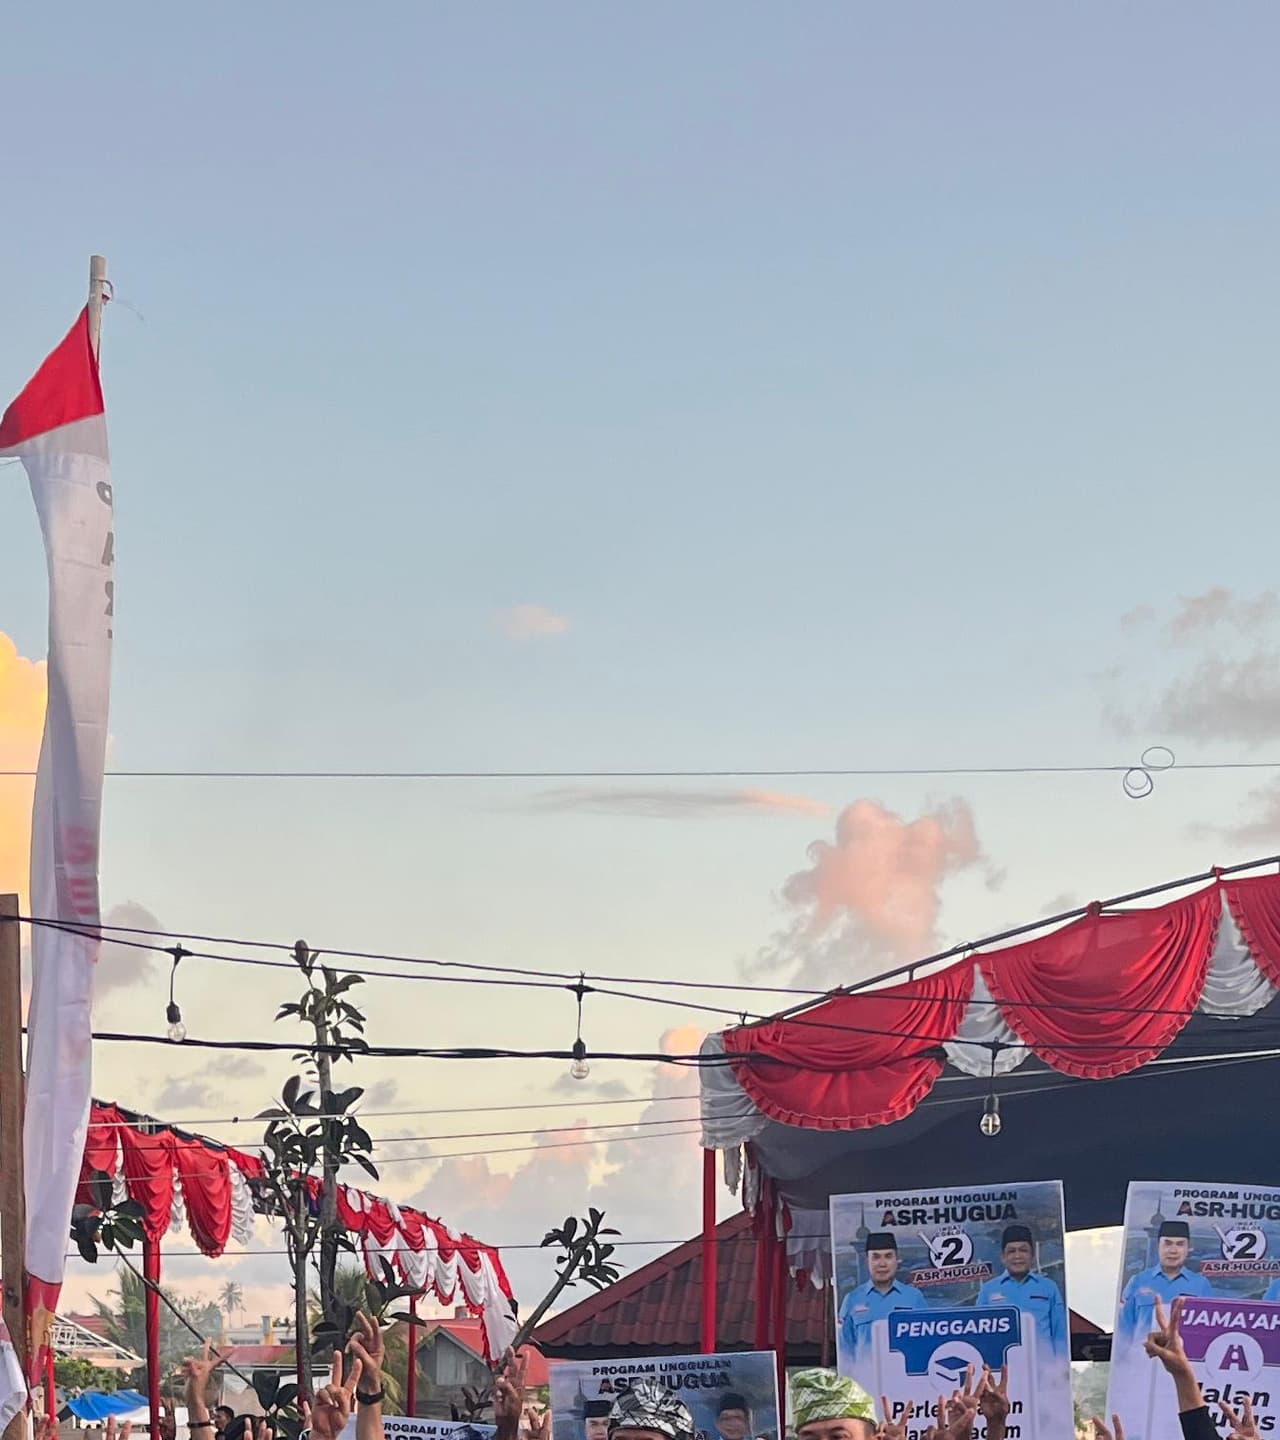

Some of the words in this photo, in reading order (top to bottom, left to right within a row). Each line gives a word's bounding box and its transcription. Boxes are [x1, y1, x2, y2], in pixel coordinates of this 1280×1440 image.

[875, 1196, 940, 1208] PROGRAM
[943, 1192, 1018, 1204] UNGGULAN
[1174, 1189, 1239, 1200] PROGRAM
[881, 1203, 1018, 1227] ASR-HUGUA
[941, 1237, 965, 1266] 2
[1233, 1232, 1257, 1259] 2
[915, 1266, 990, 1282] ASR-HUGUA
[1204, 1261, 1280, 1273] ASR-HUGUA
[896, 1317, 1010, 1337] PENGGARIS
[593, 1364, 656, 1376] PROGRAM
[659, 1360, 732, 1371] UNGGULAN
[384, 1423, 437, 1436] ROGRAM
